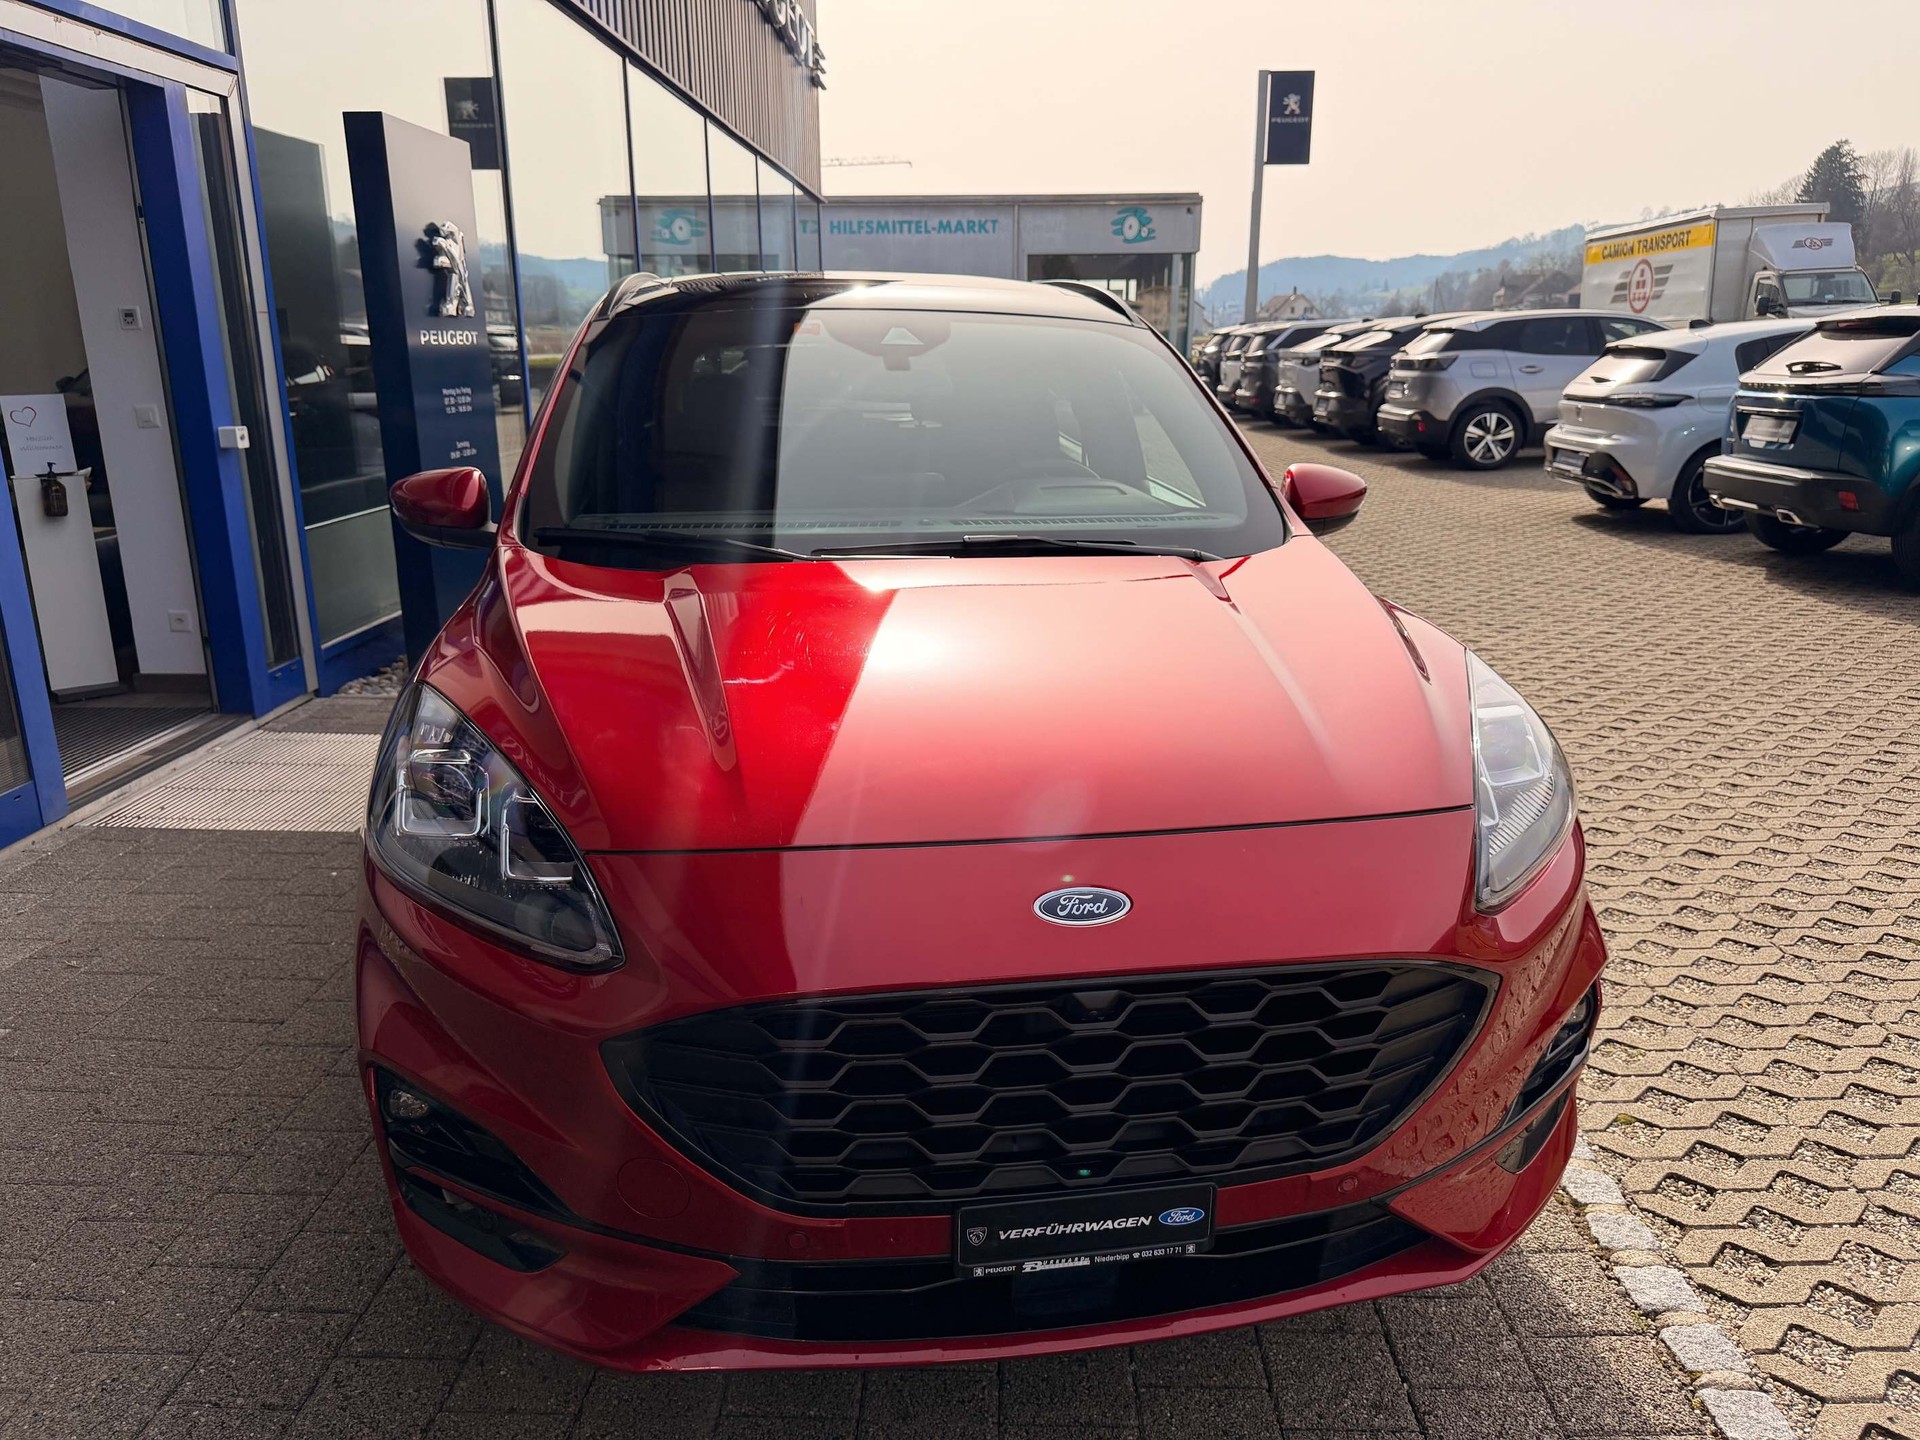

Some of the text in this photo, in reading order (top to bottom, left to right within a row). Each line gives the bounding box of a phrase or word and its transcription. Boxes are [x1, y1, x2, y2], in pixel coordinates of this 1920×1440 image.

[829, 219, 998, 235] HILFSMITTEL-MARKT
[1602, 231, 1691, 260] CAMION TRANSPORT
[420, 330, 478, 345] PEUGEOT
[1056, 894, 1108, 916] Ford
[998, 1210, 1196, 1240] VERFÜHRWAGEN Ford
[985, 1265, 1017, 1275] PEUGEOT
[1094, 1253, 1130, 1263] Niederbipp
[1141, 1250, 1153, 1258] 032
[1166, 1247, 1174, 1255] 17
[1174, 1246, 1182, 1254] 71
